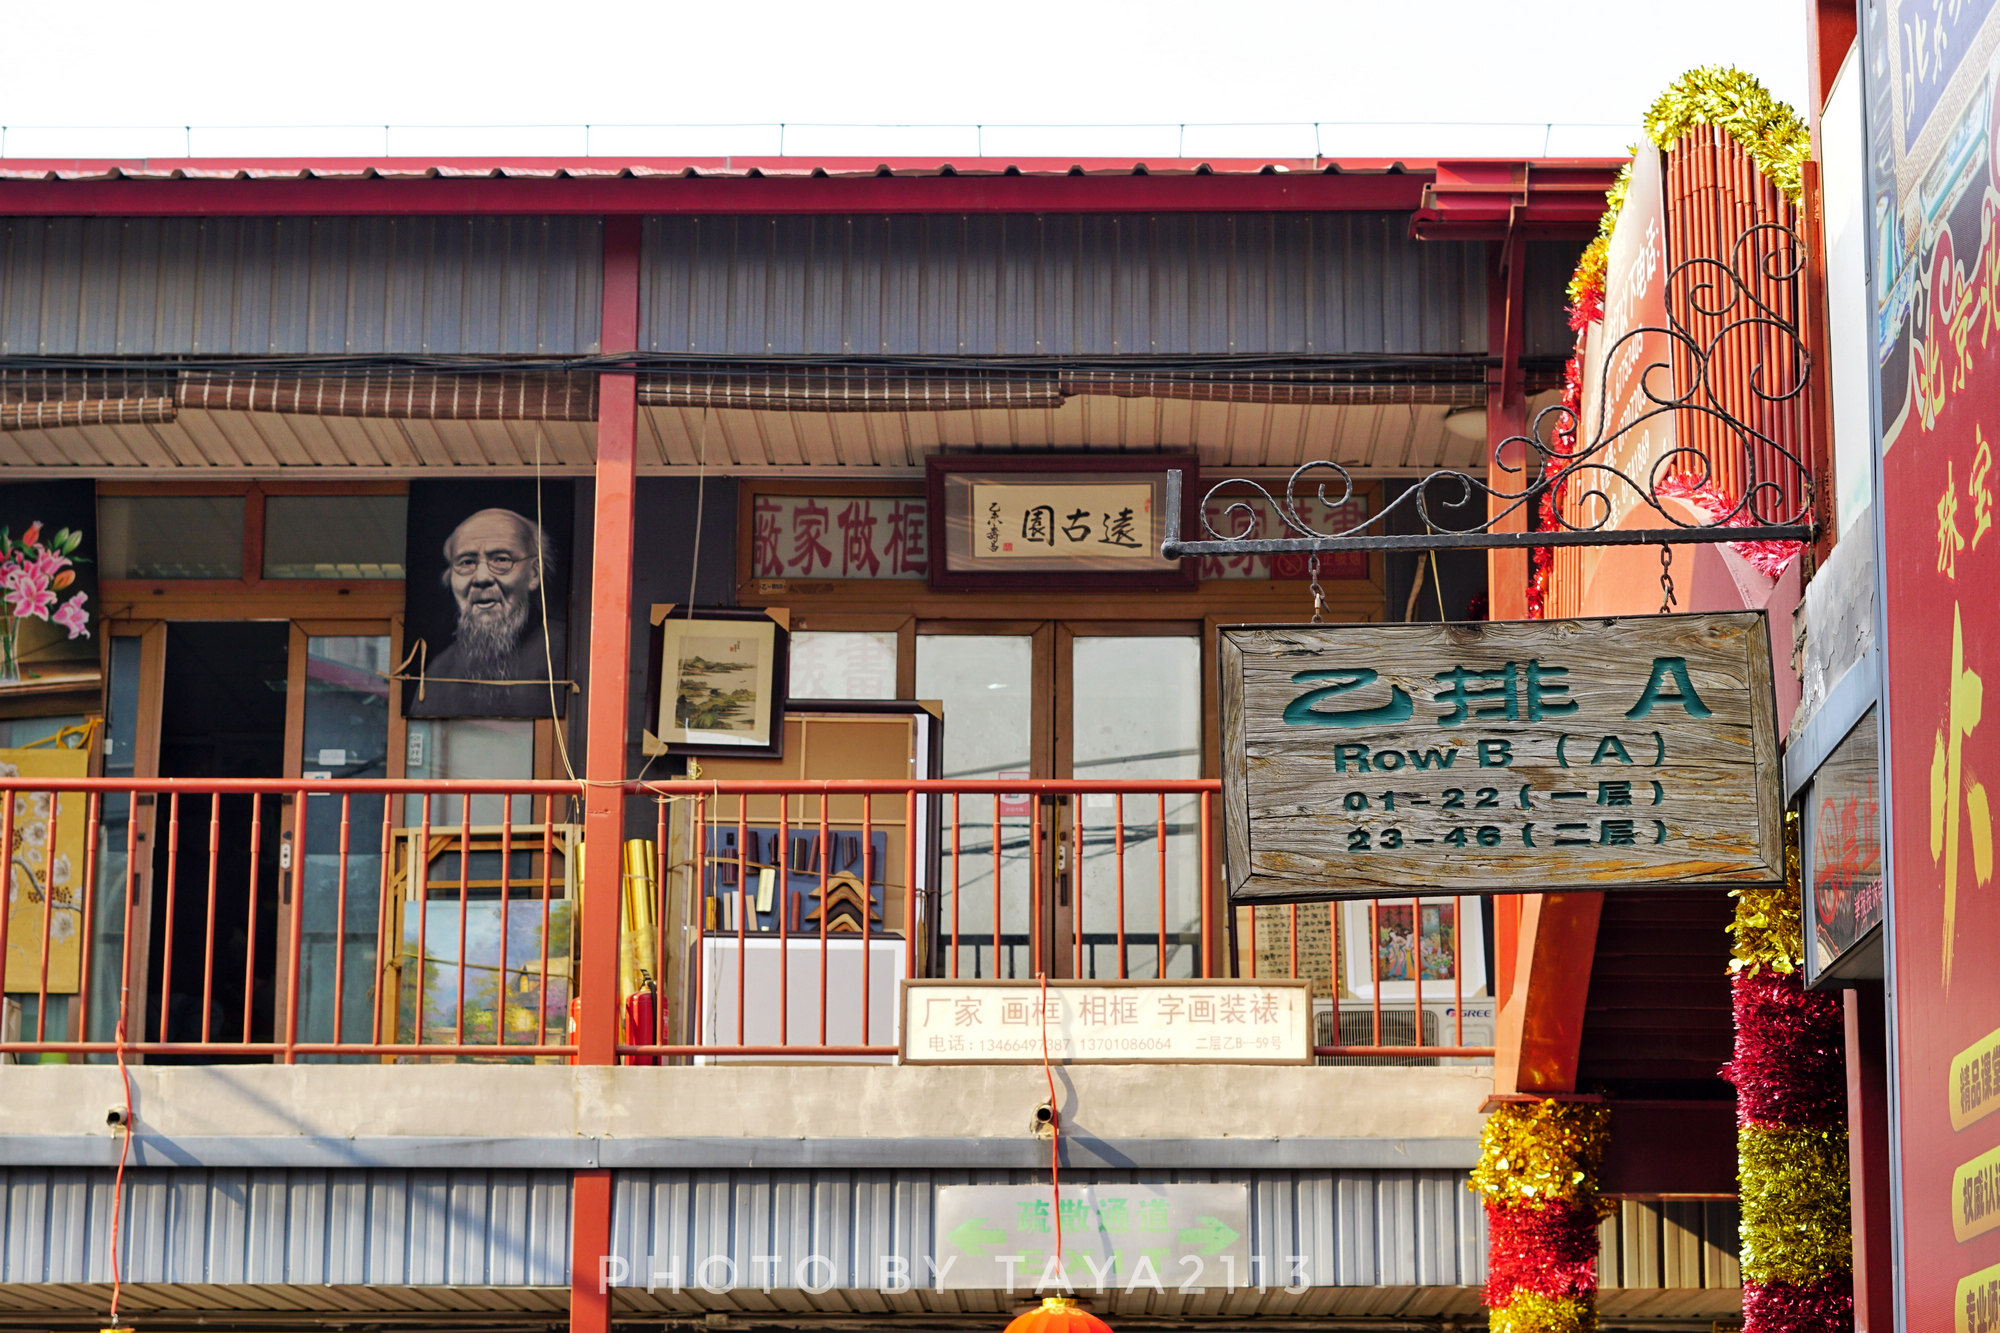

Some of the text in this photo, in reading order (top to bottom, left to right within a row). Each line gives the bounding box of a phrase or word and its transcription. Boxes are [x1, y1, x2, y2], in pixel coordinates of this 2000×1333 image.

[1937, 423, 1992, 580] 珠宝
[1283, 657, 1712, 728] 乙排 A
[1334, 743, 1457, 773] Row
[1477, 739, 1513, 769] B
[923, 993, 1279, 1028] 厂家 画框 相框 字画装裱
[1017, 1198, 1171, 1234] 疏散通道
[1017, 1249, 1171, 1275] EXIT
